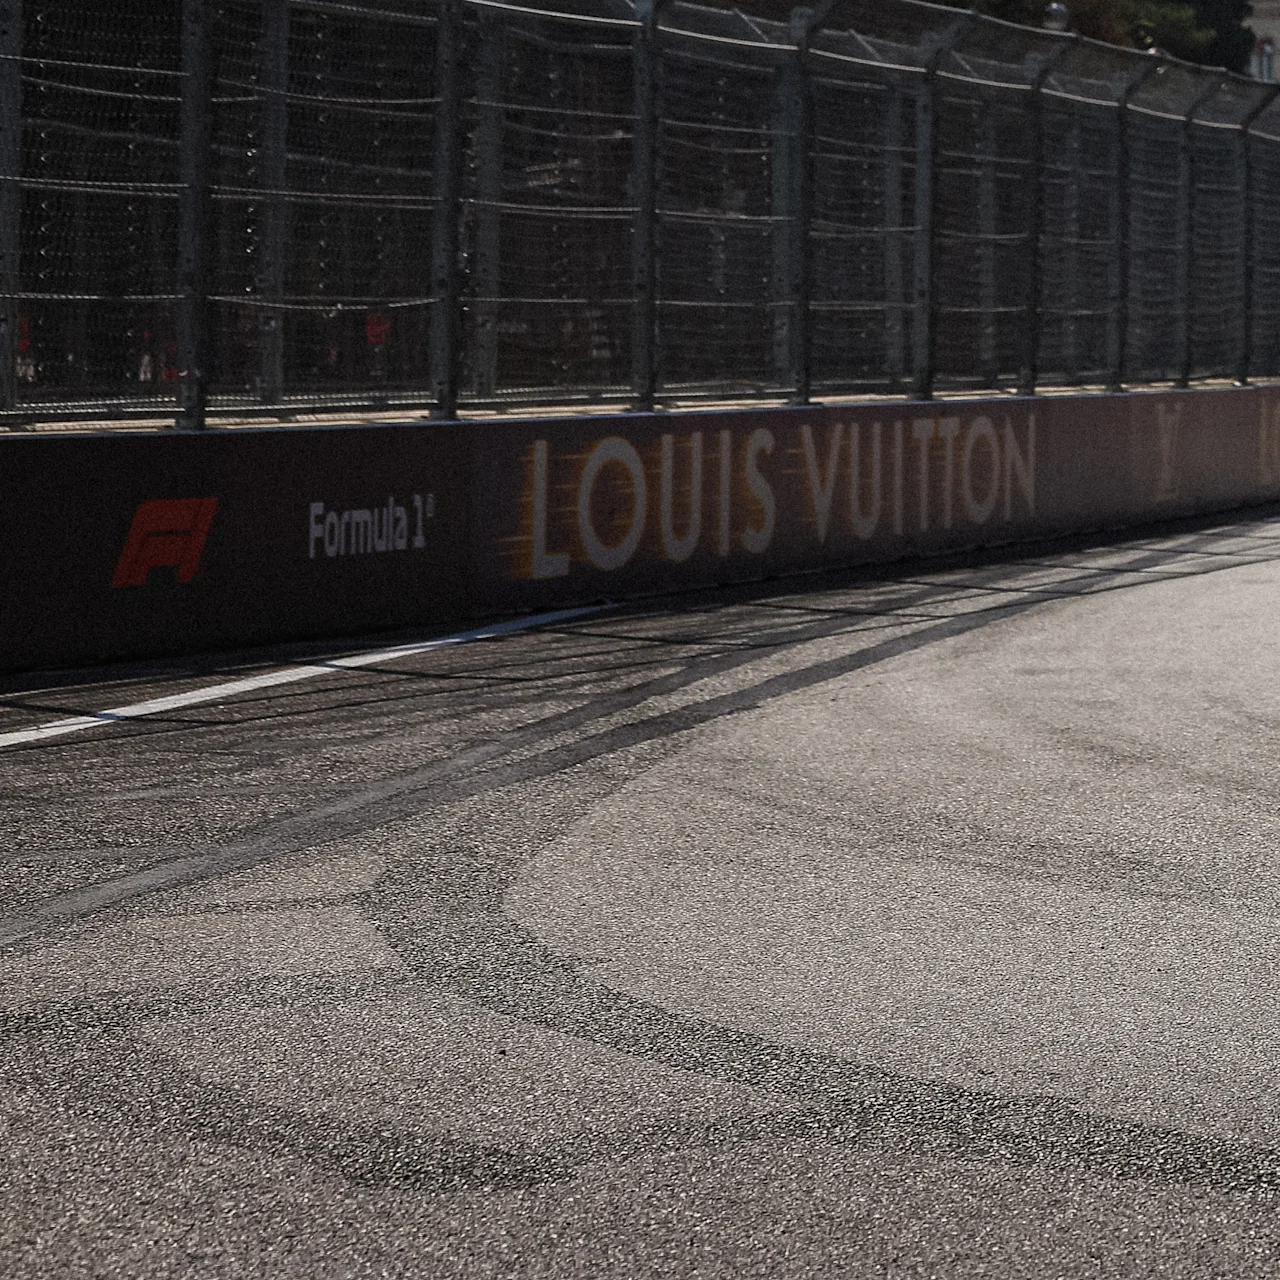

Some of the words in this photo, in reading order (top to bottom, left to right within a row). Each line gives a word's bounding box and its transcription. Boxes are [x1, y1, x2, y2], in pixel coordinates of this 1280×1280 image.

[309, 496, 408, 559] Formula
[532, 428, 776, 579] LOUIS
[801, 414, 1036, 545] VUITTON
